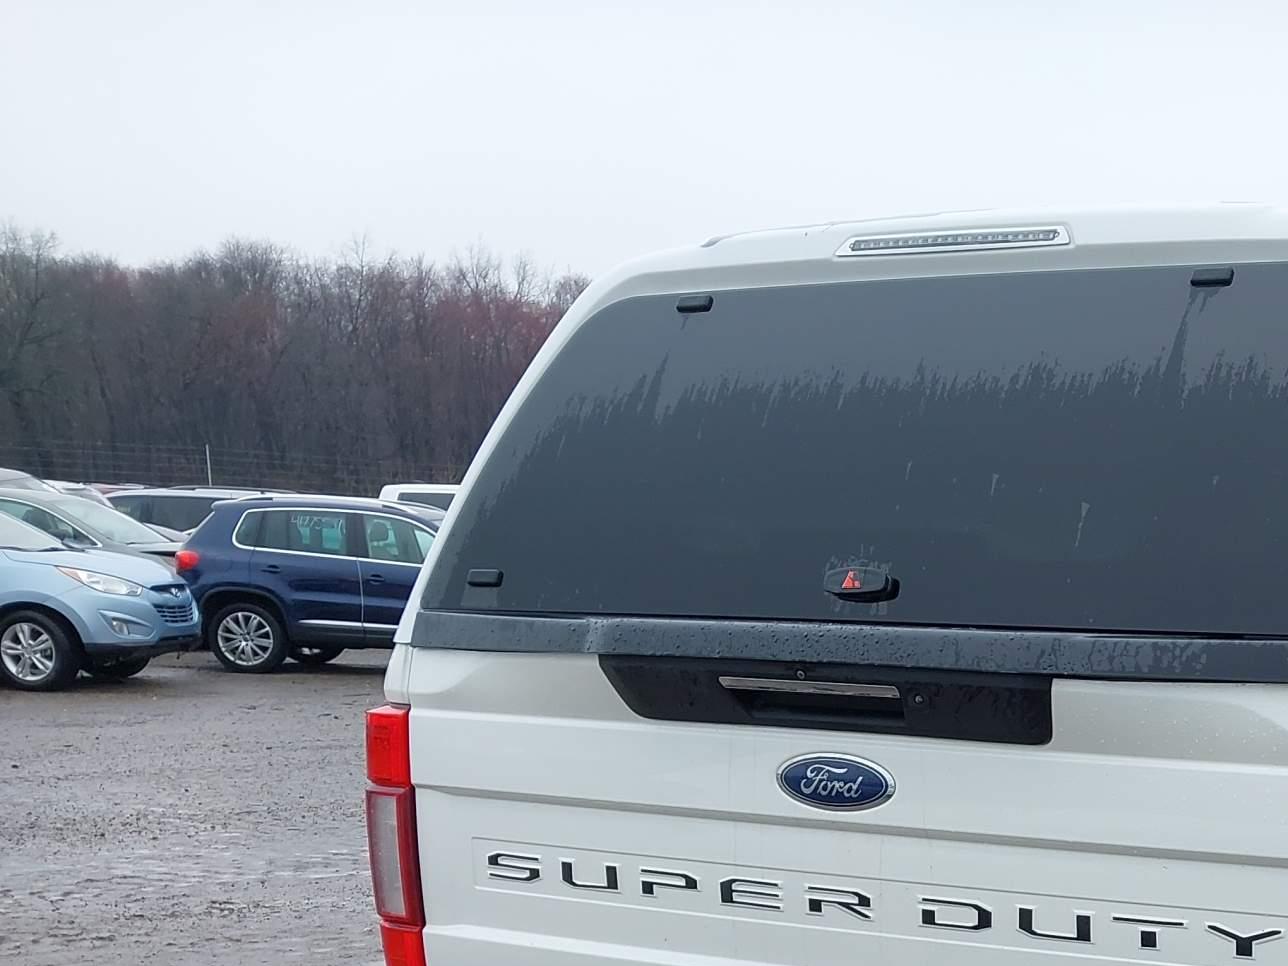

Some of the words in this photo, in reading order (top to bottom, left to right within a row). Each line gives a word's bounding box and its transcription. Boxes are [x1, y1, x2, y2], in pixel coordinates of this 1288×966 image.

[800, 764, 863, 798] Ford
[486, 850, 873, 921] SUPER
[919, 895, 1284, 959] DUTY
